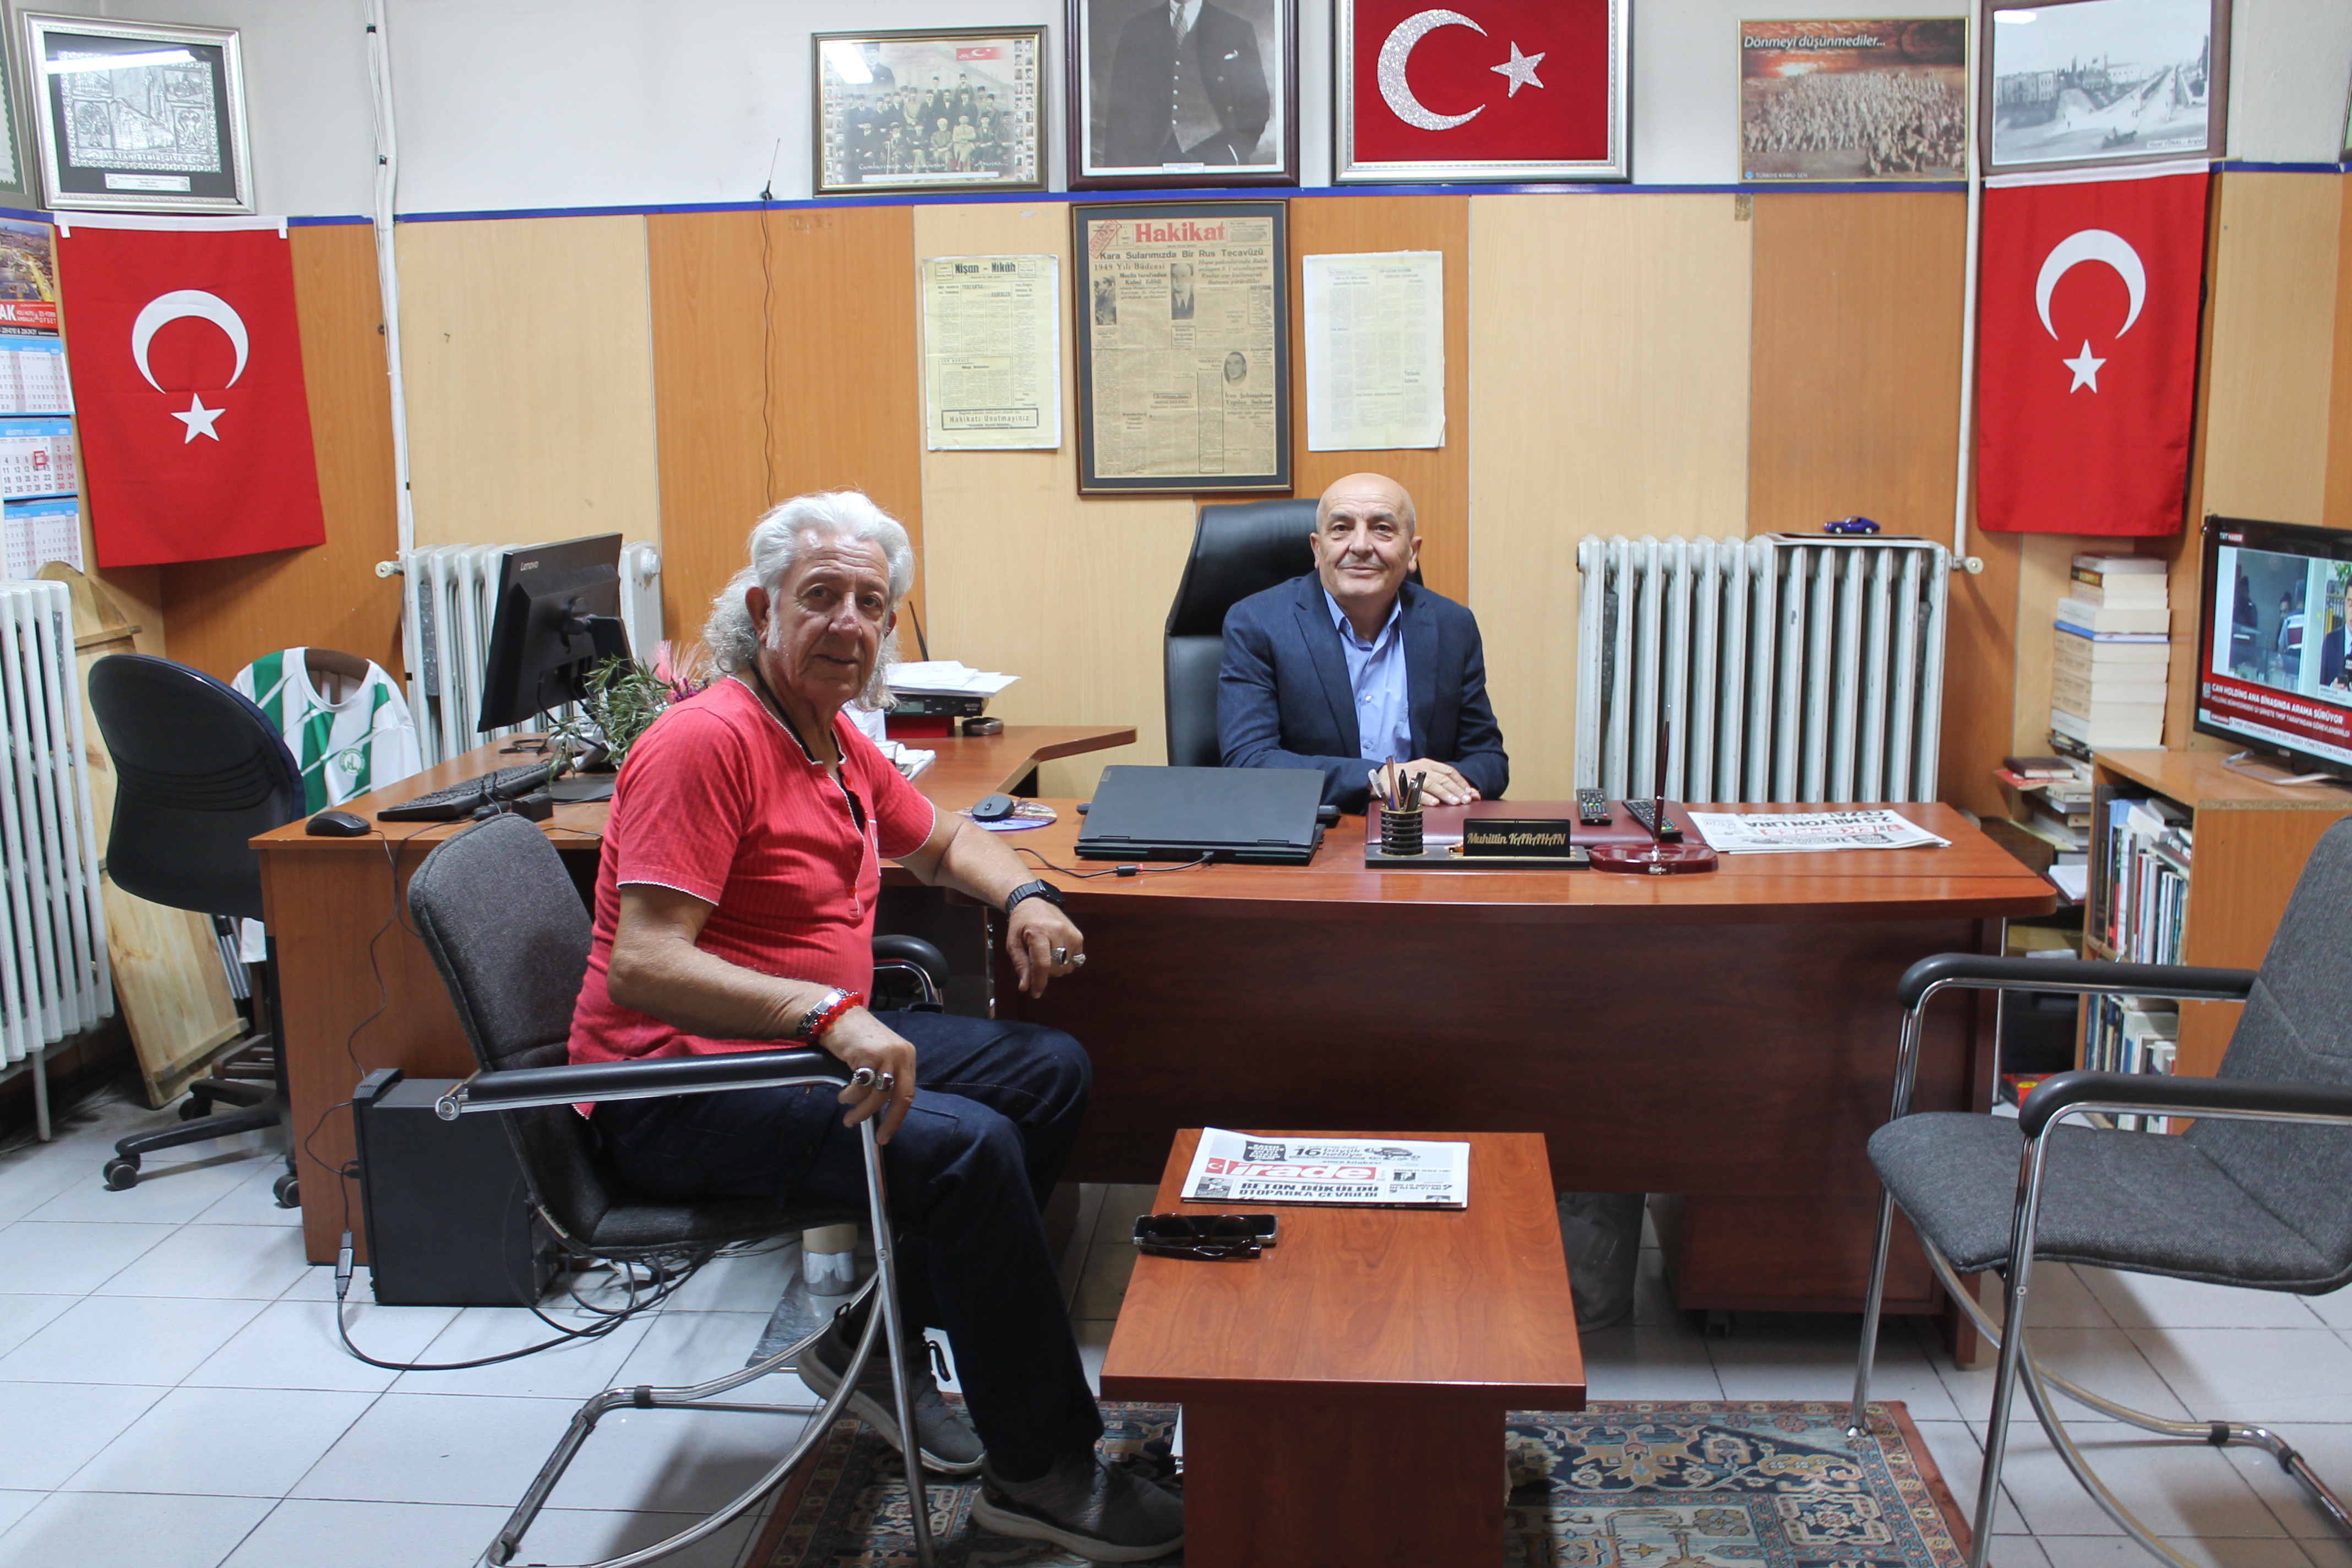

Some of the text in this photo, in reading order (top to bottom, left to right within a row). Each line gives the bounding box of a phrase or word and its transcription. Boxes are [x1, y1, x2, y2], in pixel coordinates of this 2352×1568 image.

[1744, 34, 1885, 50] Dönmeyi düşünmediler...
[1135, 221, 1226, 243] Hakikat
[1100, 247, 1264, 260] Kara Sularımızda Bir Rus Tecavüzü
[955, 263, 979, 274] Nişan
[991, 262, 1016, 273] Nikâh
[1117, 262, 1131, 270] Yılı
[984, 415, 1030, 423] Unutmayınız
[520, 561, 539, 571] Lenovo
[2212, 683, 2223, 694] CAN
[2247, 692, 2260, 704] ANA
[2291, 703, 2312, 717] ARAMA
[2313, 706, 2344, 725] SÜRÜYOR
[1765, 826, 1875, 837] EKSPRES
[1467, 832, 1566, 846] Muhittin KARAHAN
[1293, 1148, 1321, 1156] 16
[1229, 1162, 1374, 1180] irade
[1301, 1184, 1379, 1192] DÖKÜLDÜ
